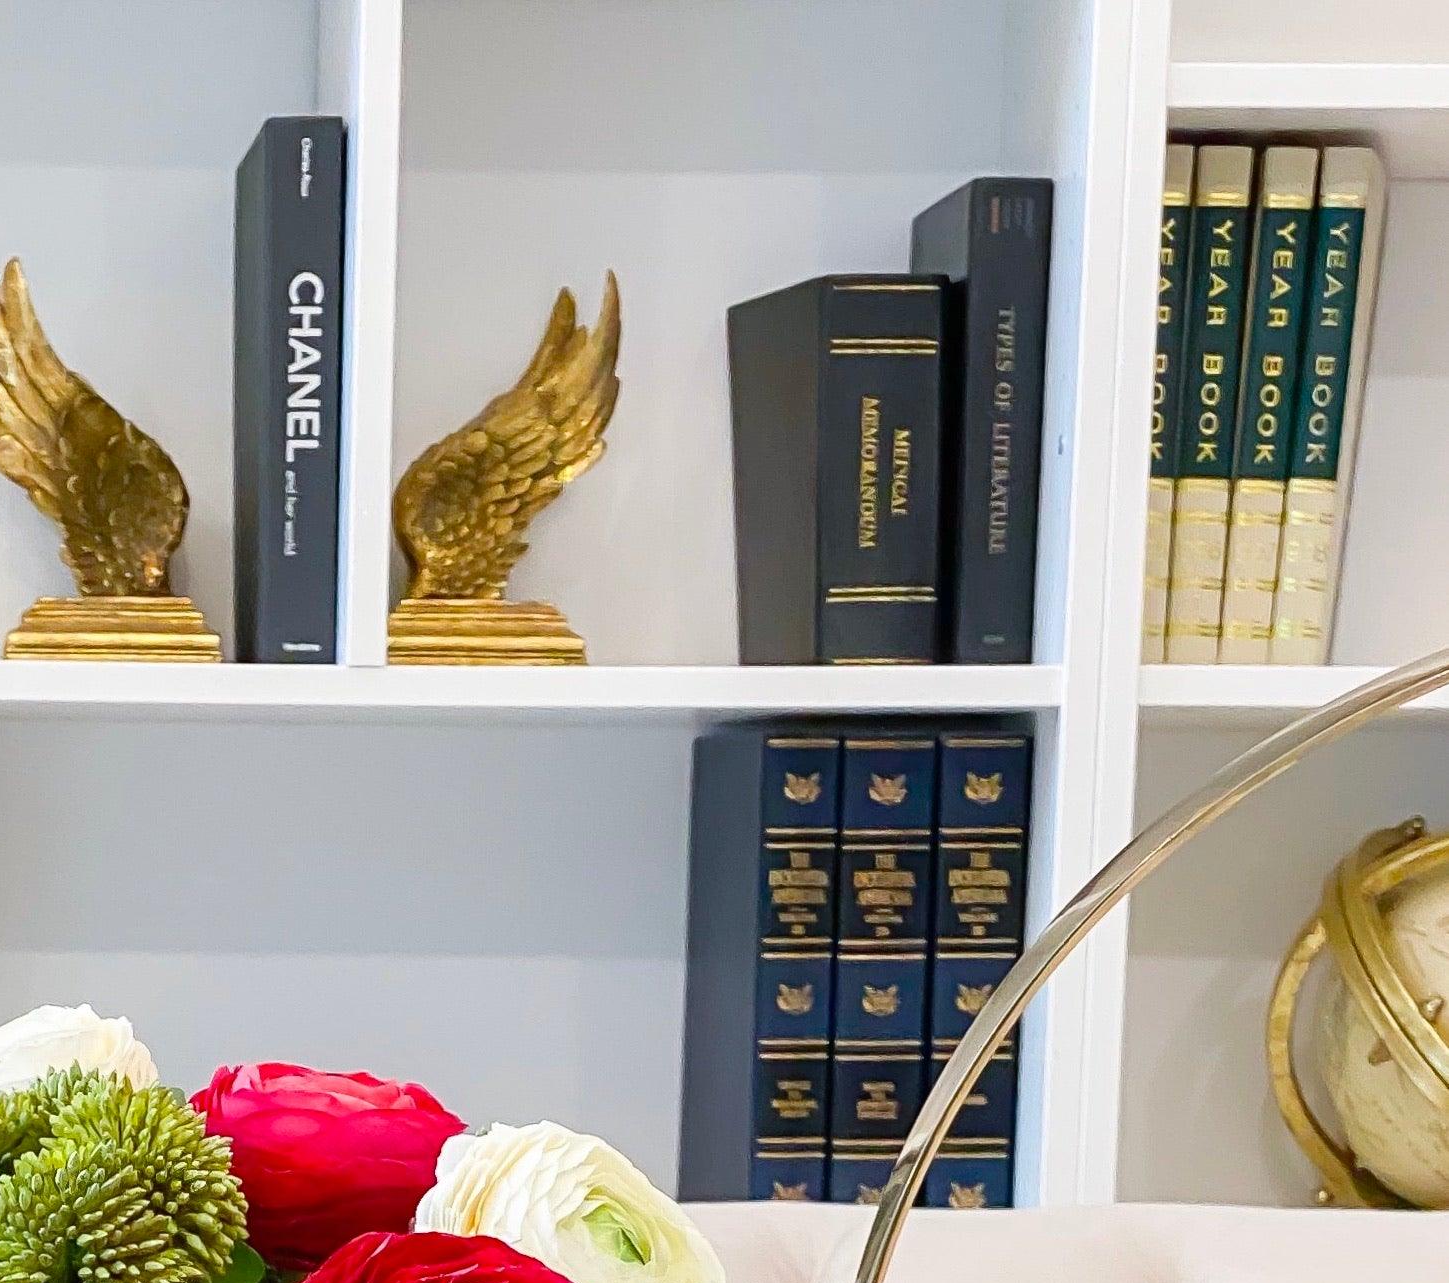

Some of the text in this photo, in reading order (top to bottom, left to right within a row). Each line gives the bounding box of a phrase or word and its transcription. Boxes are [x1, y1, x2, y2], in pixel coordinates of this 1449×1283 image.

[287, 272, 325, 463] CHANEL
[993, 382, 1014, 410] OF
[995, 307, 1016, 373] TYPES
[1196, 219, 1234, 463] YEAR BOOK
[1254, 221, 1298, 464] YEAR BOOK
[1305, 222, 1350, 463] YEAR BOOK
